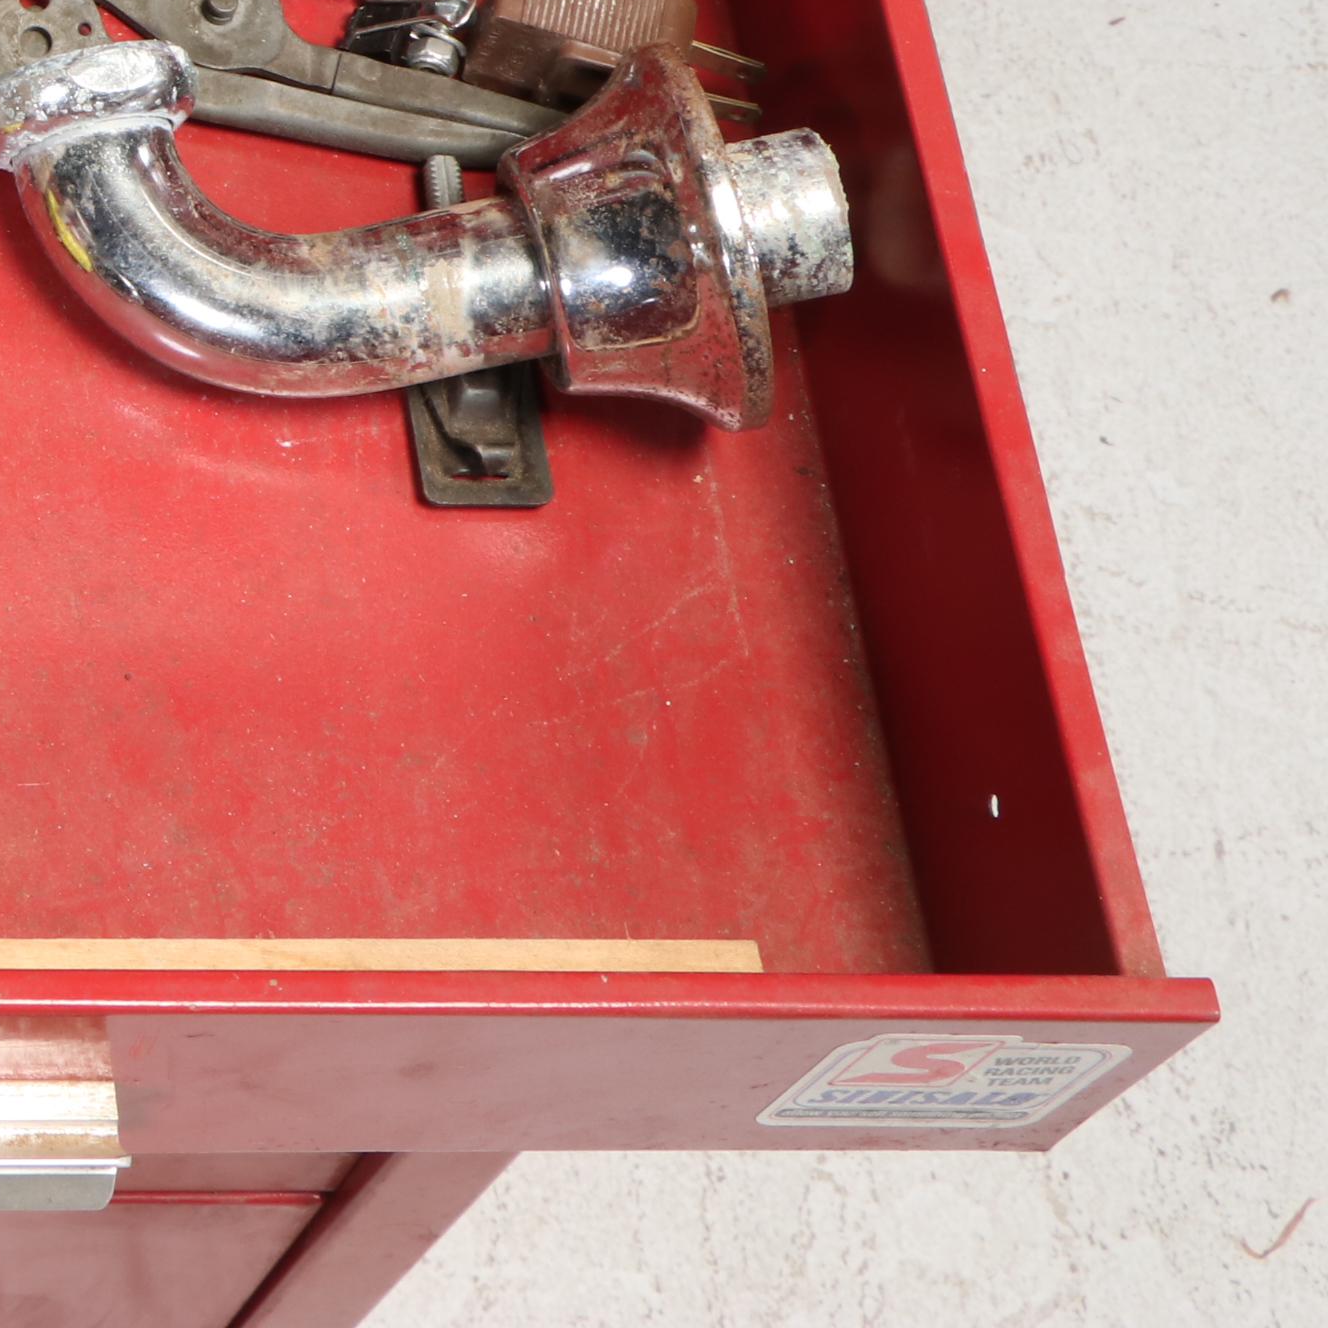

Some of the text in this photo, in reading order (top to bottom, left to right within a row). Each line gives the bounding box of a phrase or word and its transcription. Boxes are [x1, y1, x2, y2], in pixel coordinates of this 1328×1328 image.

[994, 1056, 1081, 1066] WORLD
[984, 1066, 1075, 1076] RACING
[987, 1077, 1053, 1087] TEAM
